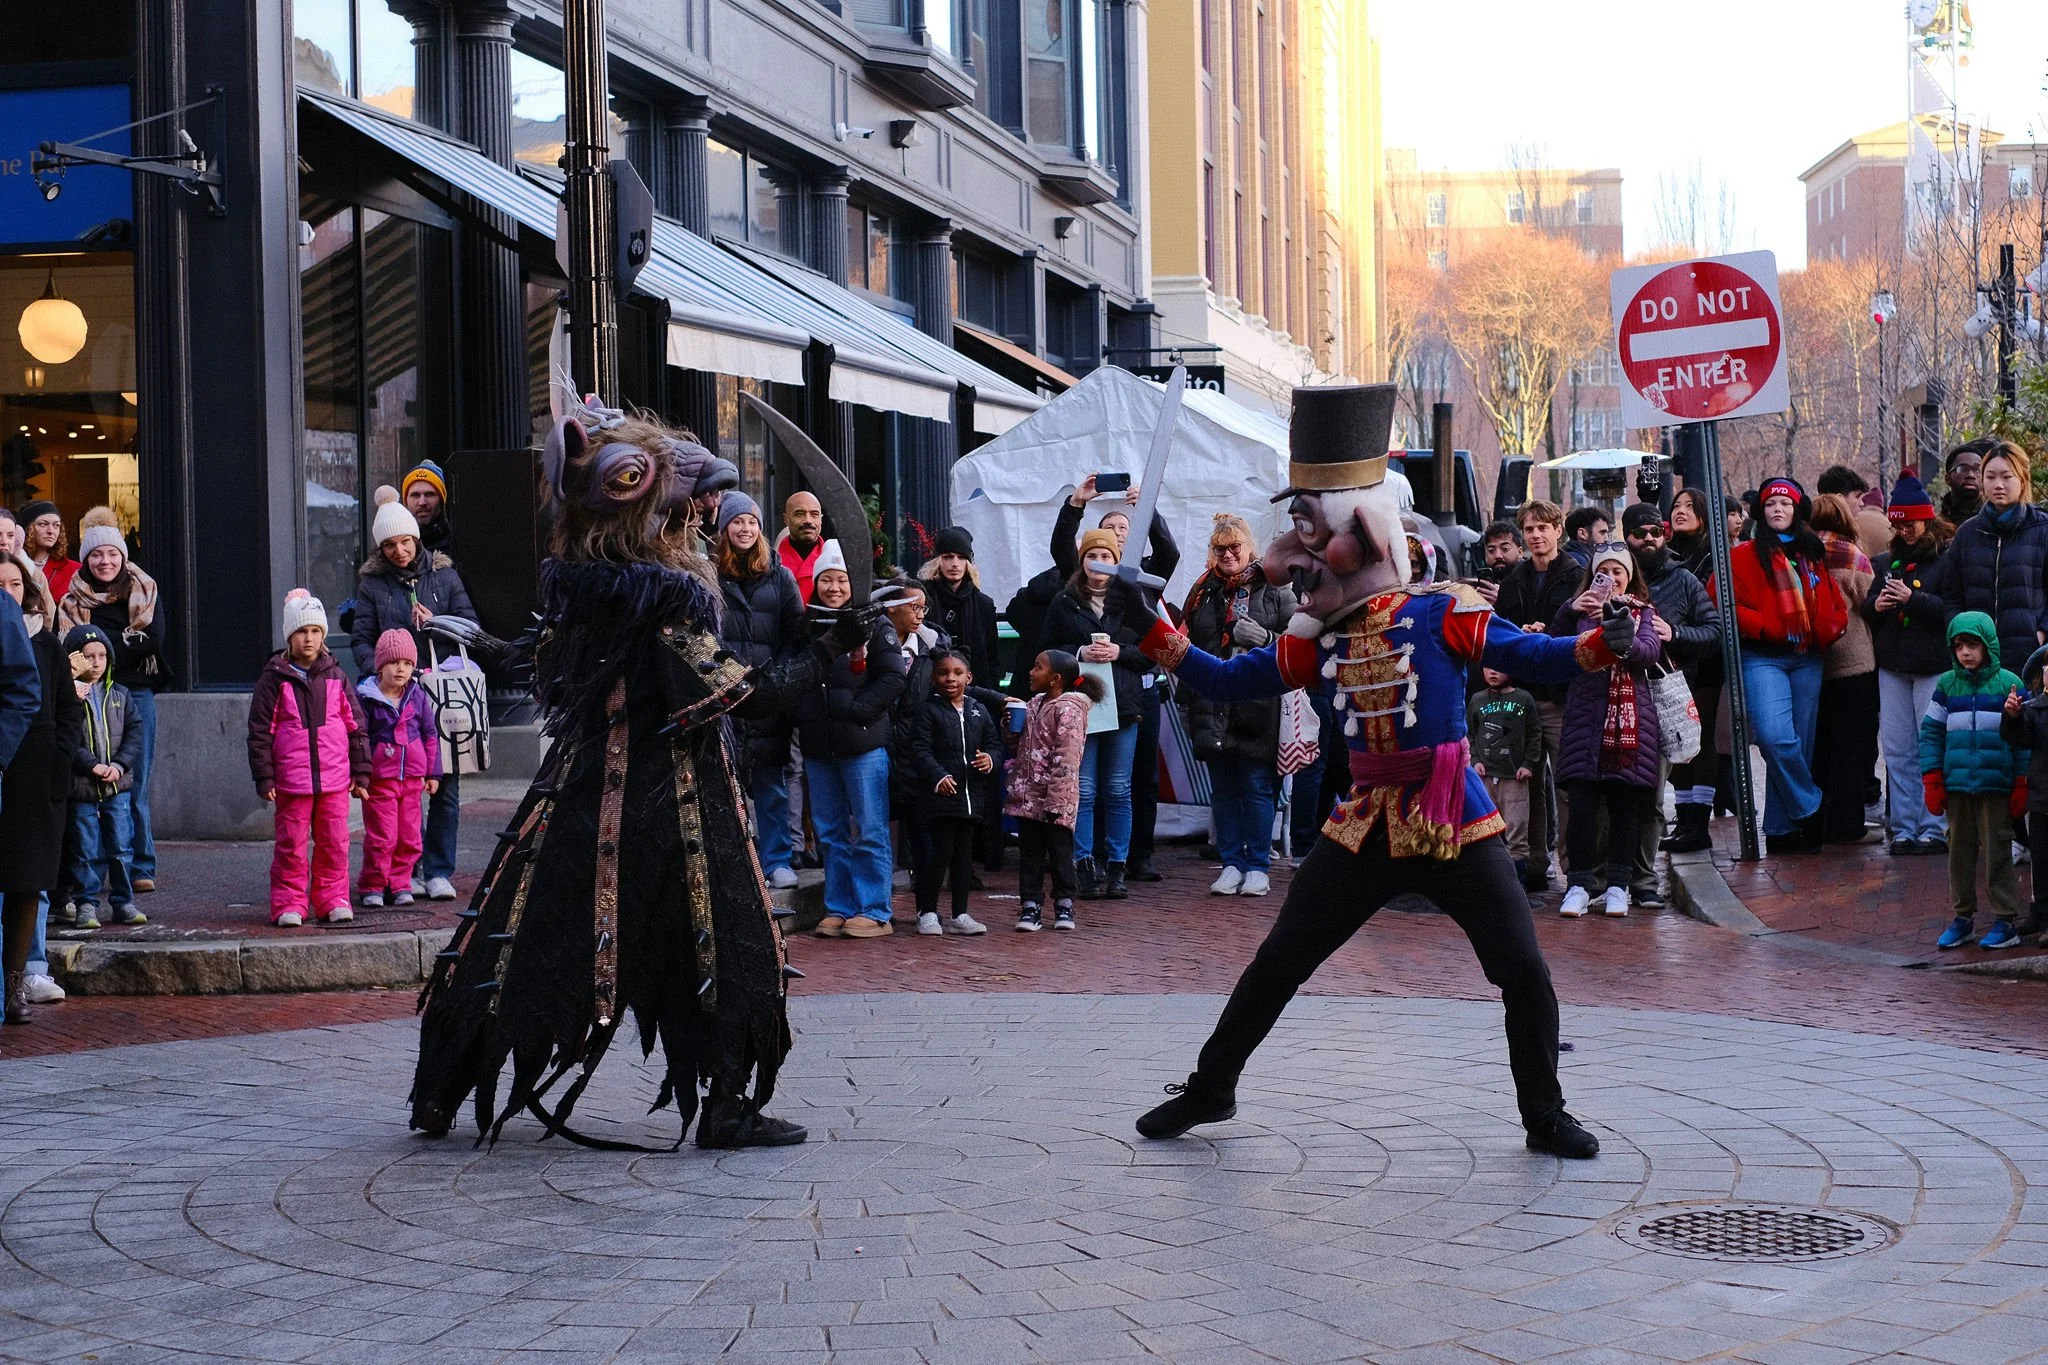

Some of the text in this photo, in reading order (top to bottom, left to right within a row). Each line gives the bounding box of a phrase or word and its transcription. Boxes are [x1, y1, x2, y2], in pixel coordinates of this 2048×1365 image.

[1640, 287, 1751, 323] DO NOT
[1657, 358, 1748, 392] ENTER
[1890, 511, 1905, 519] PVD
